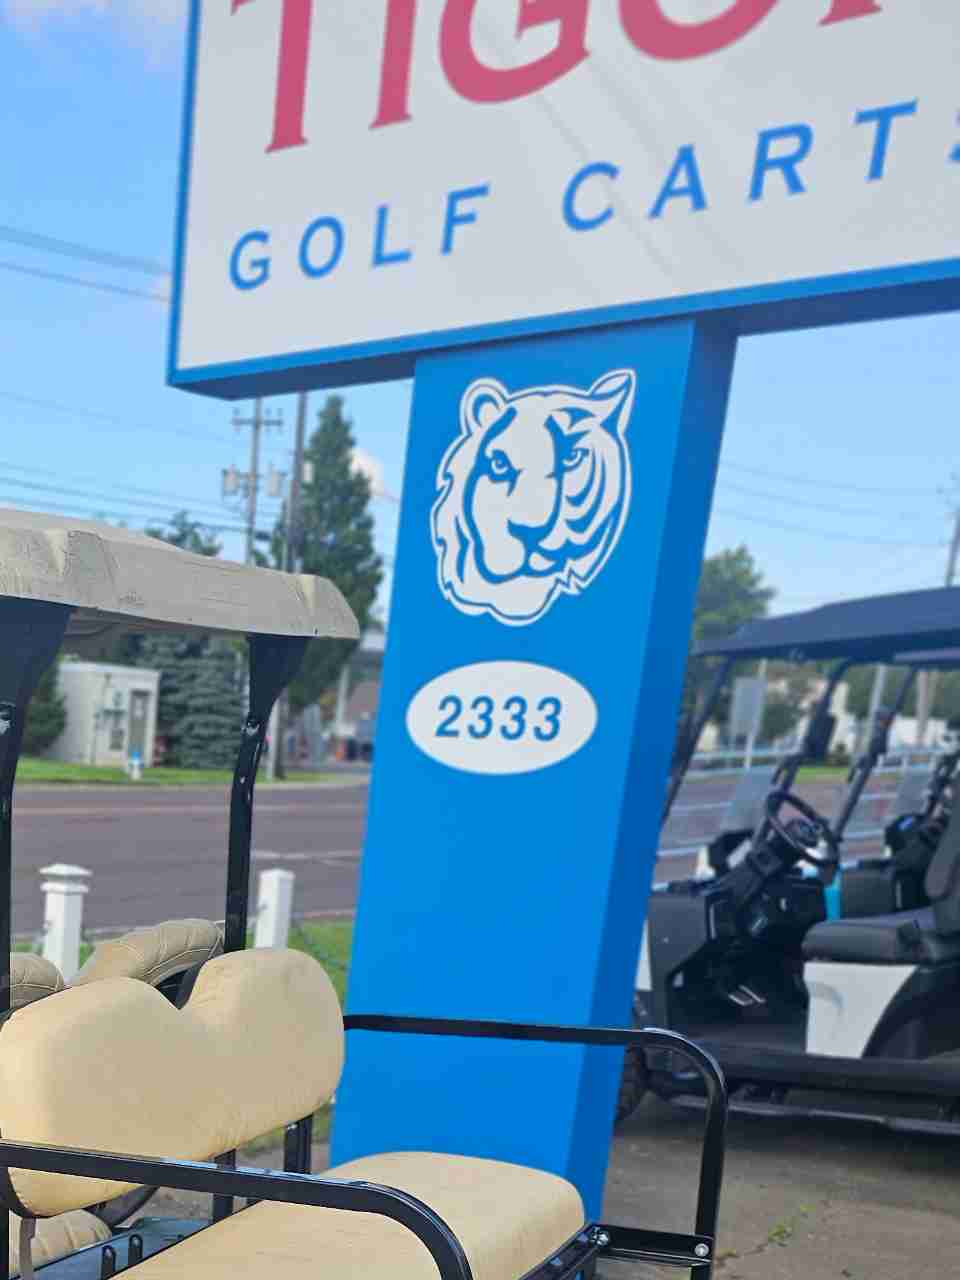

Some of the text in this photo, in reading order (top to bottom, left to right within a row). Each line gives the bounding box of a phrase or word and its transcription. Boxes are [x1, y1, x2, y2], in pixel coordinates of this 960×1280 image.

[232, 0, 882, 151] TIG
[227, 98, 960, 290] GOLF CART
[435, 695, 562, 742] 2333
